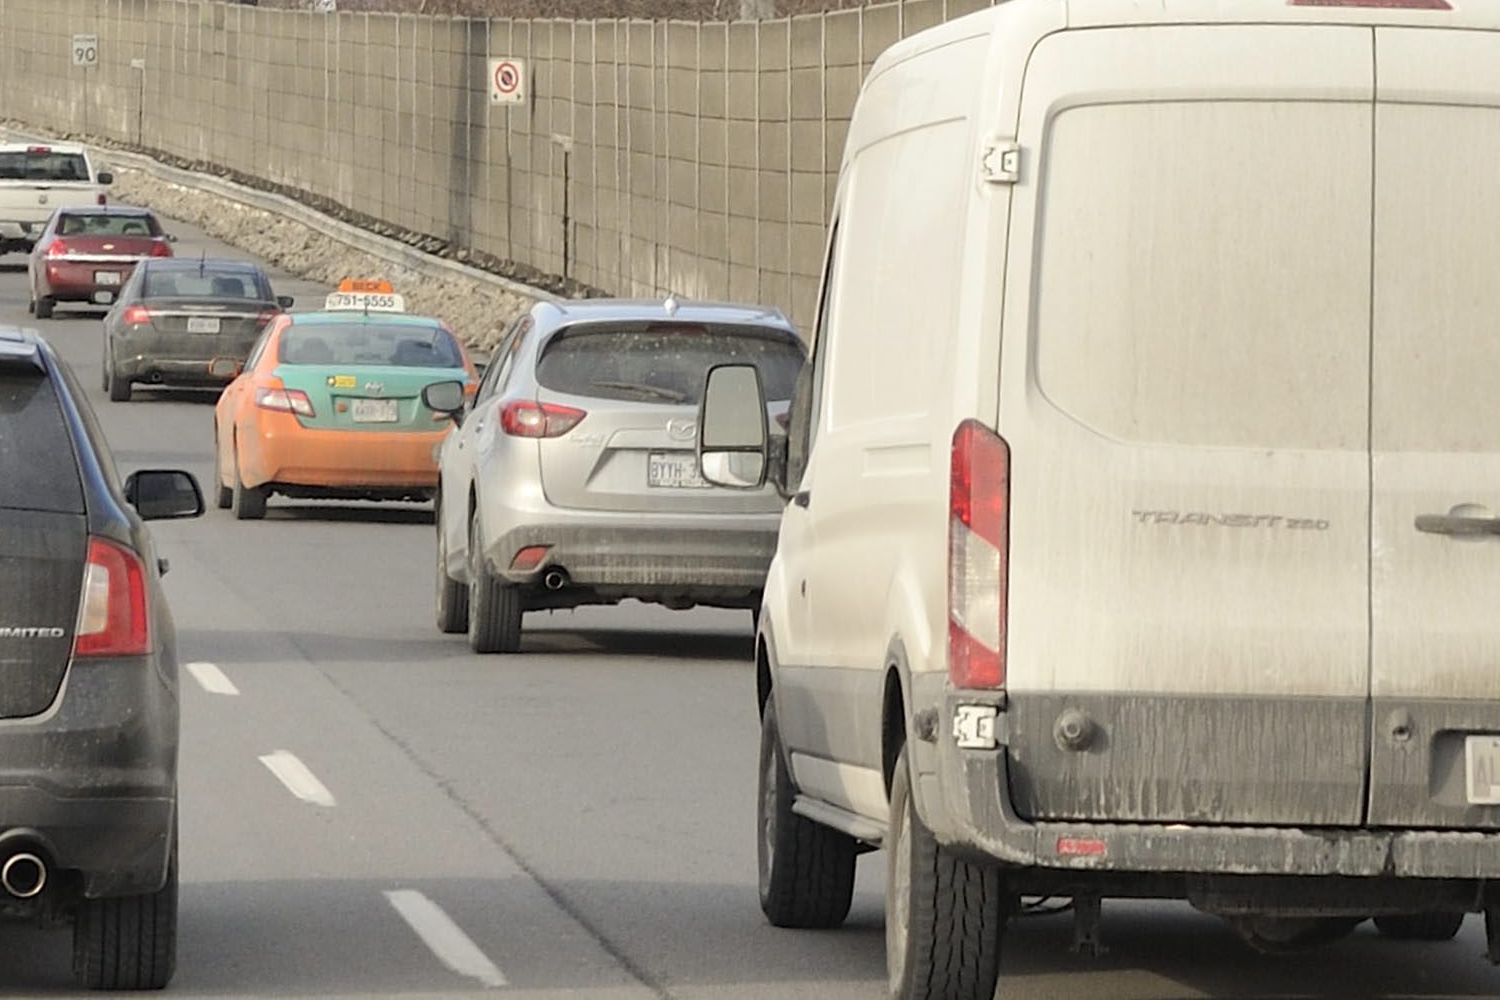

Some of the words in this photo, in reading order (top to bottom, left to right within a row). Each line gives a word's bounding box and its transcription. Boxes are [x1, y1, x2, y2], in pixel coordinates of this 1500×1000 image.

[75, 46, 96, 62] 90
[352, 281, 379, 290] BECK
[337, 294, 395, 308] 751-5555
[1131, 509, 1284, 528] TRANSIT
